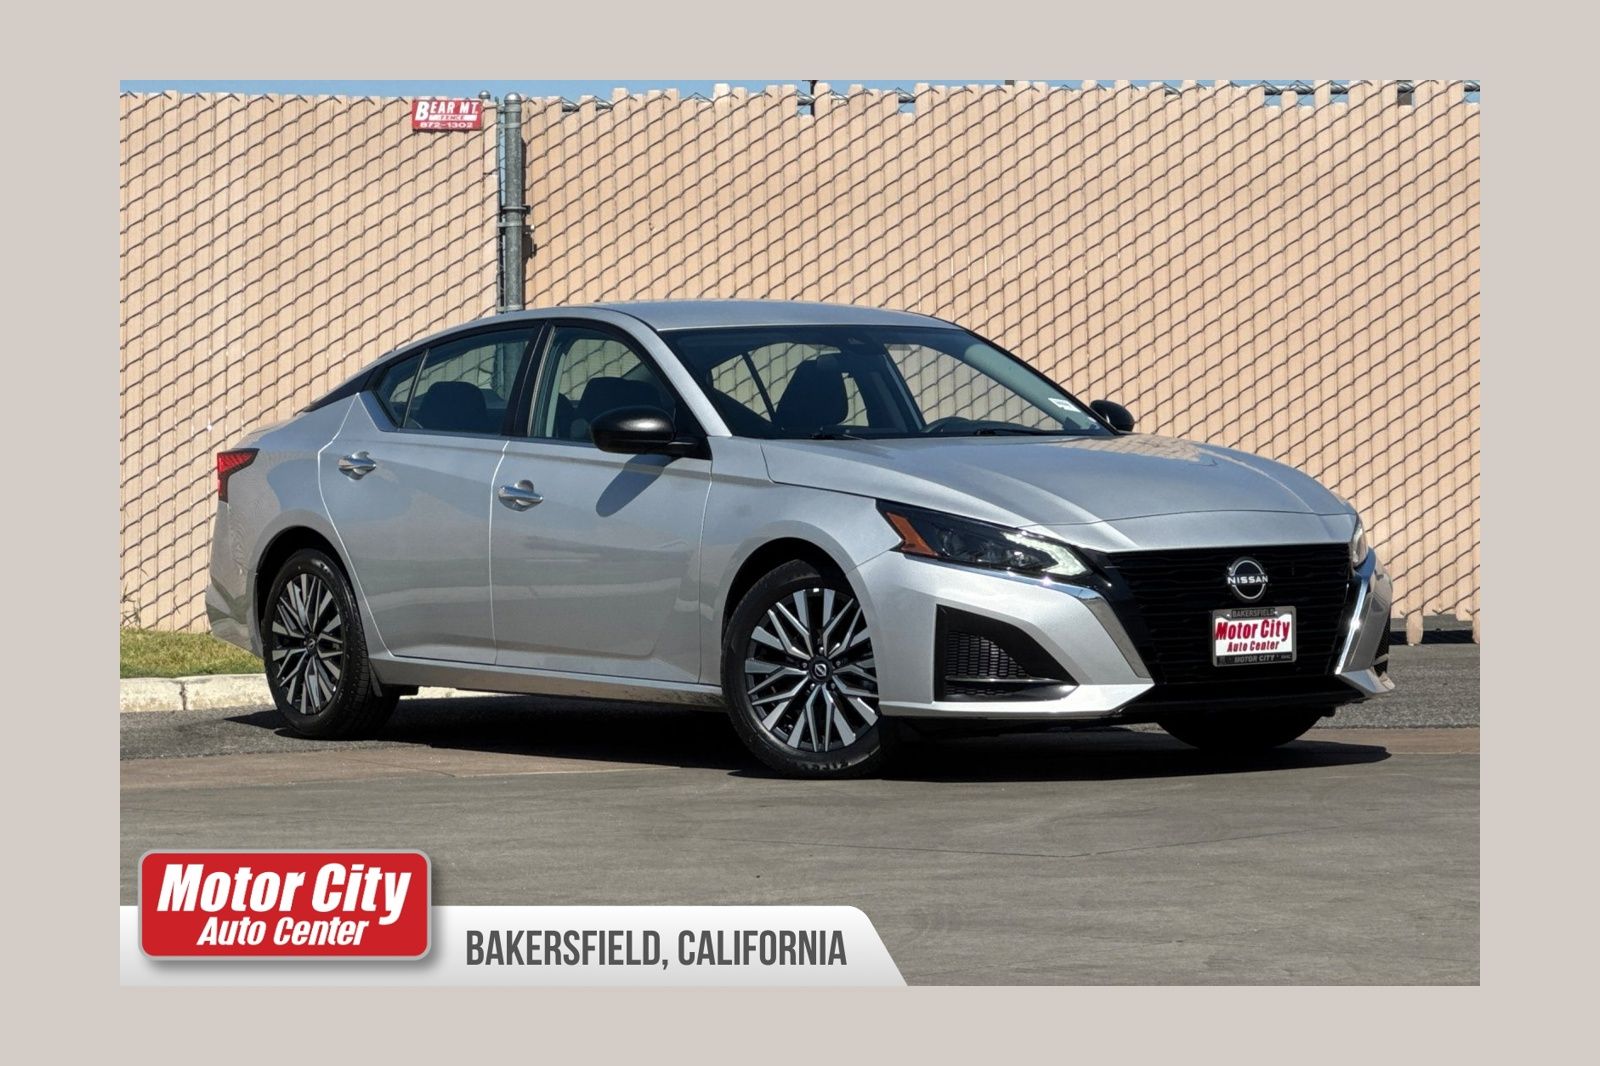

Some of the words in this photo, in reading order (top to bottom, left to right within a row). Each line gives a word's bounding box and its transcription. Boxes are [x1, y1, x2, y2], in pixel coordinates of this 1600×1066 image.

[415, 101, 455, 121] BEAR
[460, 101, 479, 114] MT.
[1227, 575, 1268, 585] NISSAN
[1233, 608, 1275, 617] BAKERSFIELD
[1216, 622, 1258, 640] Motor
[1260, 619, 1290, 641] City
[1227, 642, 1248, 652] Auto
[1249, 640, 1279, 651] Center
[1234, 655, 1258, 663] MOTOR
[1259, 654, 1275, 662] CITY
